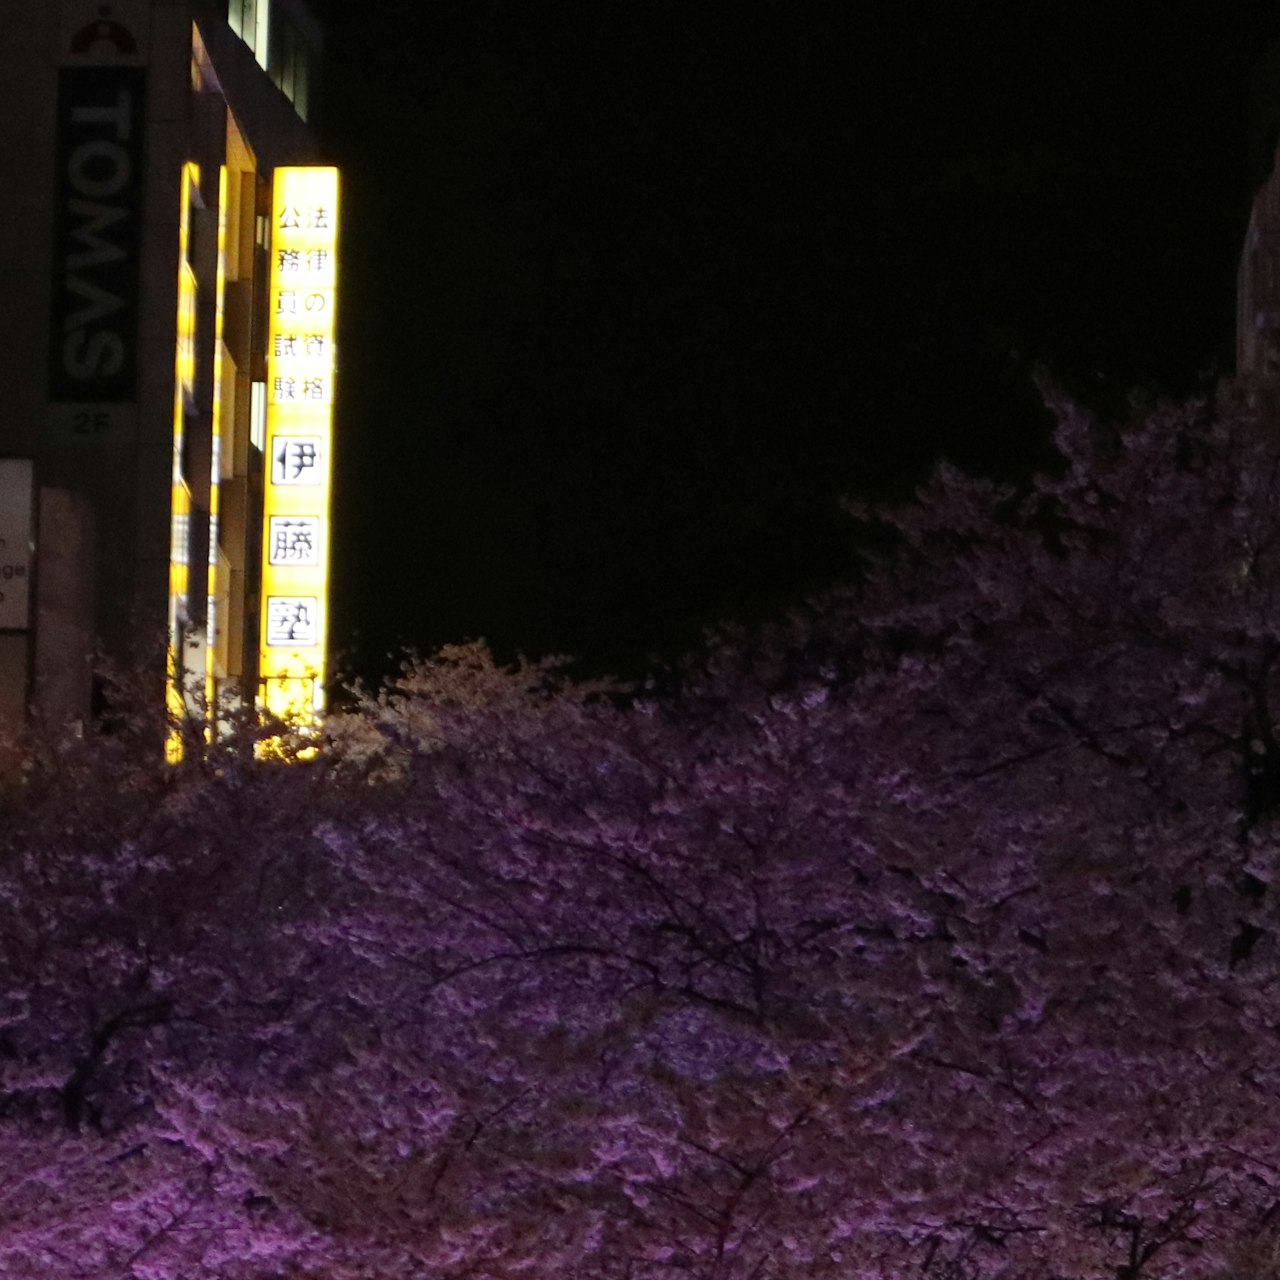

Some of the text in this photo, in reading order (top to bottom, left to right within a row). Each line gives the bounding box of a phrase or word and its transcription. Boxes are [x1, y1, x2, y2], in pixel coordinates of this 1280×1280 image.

[63, 89, 132, 380] TOMAS
[274, 206, 300, 400] 公務員試験
[303, 206, 329, 400] 法律の資格
[72, 412, 110, 435] 2F
[270, 441, 317, 641] 伊藤塾
